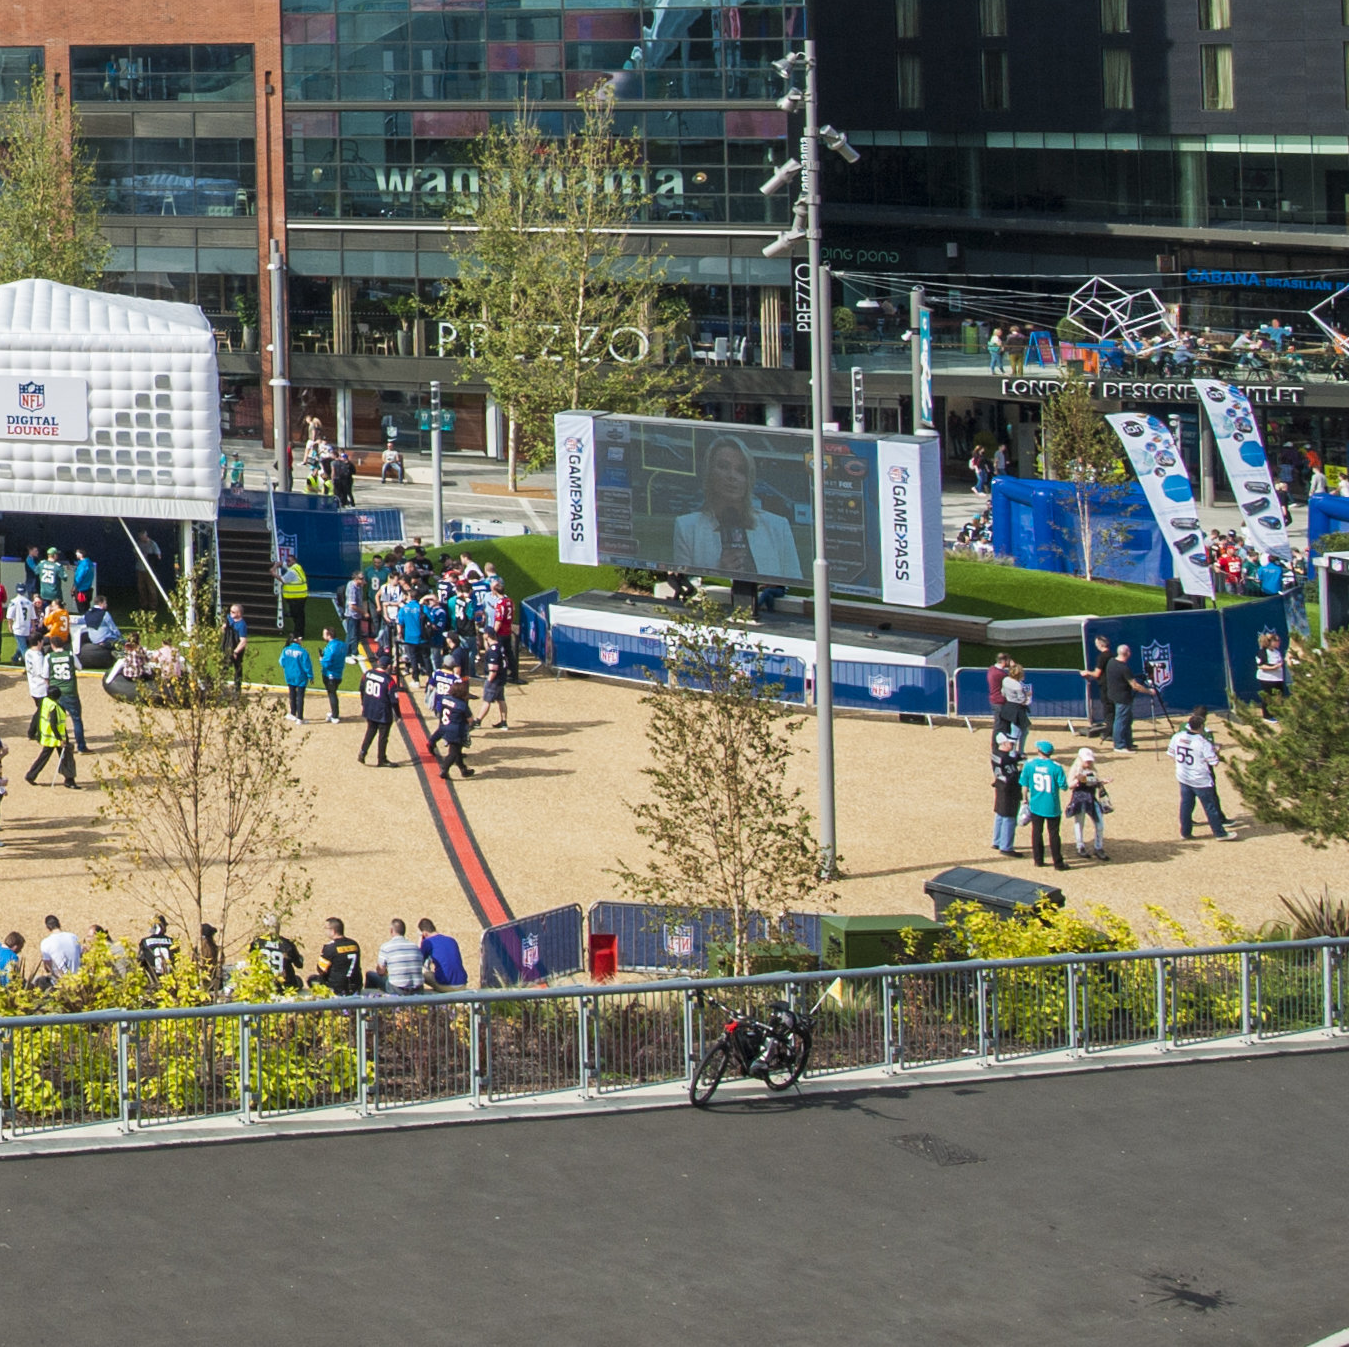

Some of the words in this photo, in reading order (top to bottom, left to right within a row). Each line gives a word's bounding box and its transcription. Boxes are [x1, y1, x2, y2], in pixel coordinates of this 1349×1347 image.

[1187, 268, 1261, 287] CABANA
[1265, 277, 1333, 291] BRASILIAN
[438, 322, 649, 363] PRZZO
[1103, 382, 1200, 401] DESIGNE
[22, 394, 43, 409] NFL
[6, 415, 59, 426] DIGITAL
[7, 426, 59, 436] LOUNGE
[41, 569, 54, 584] 25
[371, 578, 380, 591] 8
[59, 615, 68, 632] 3
[365, 680, 381, 697] 80
[1176, 745, 1195, 766] 55
[1033, 772, 1051, 792] 91
[347, 953, 357, 977] 7
